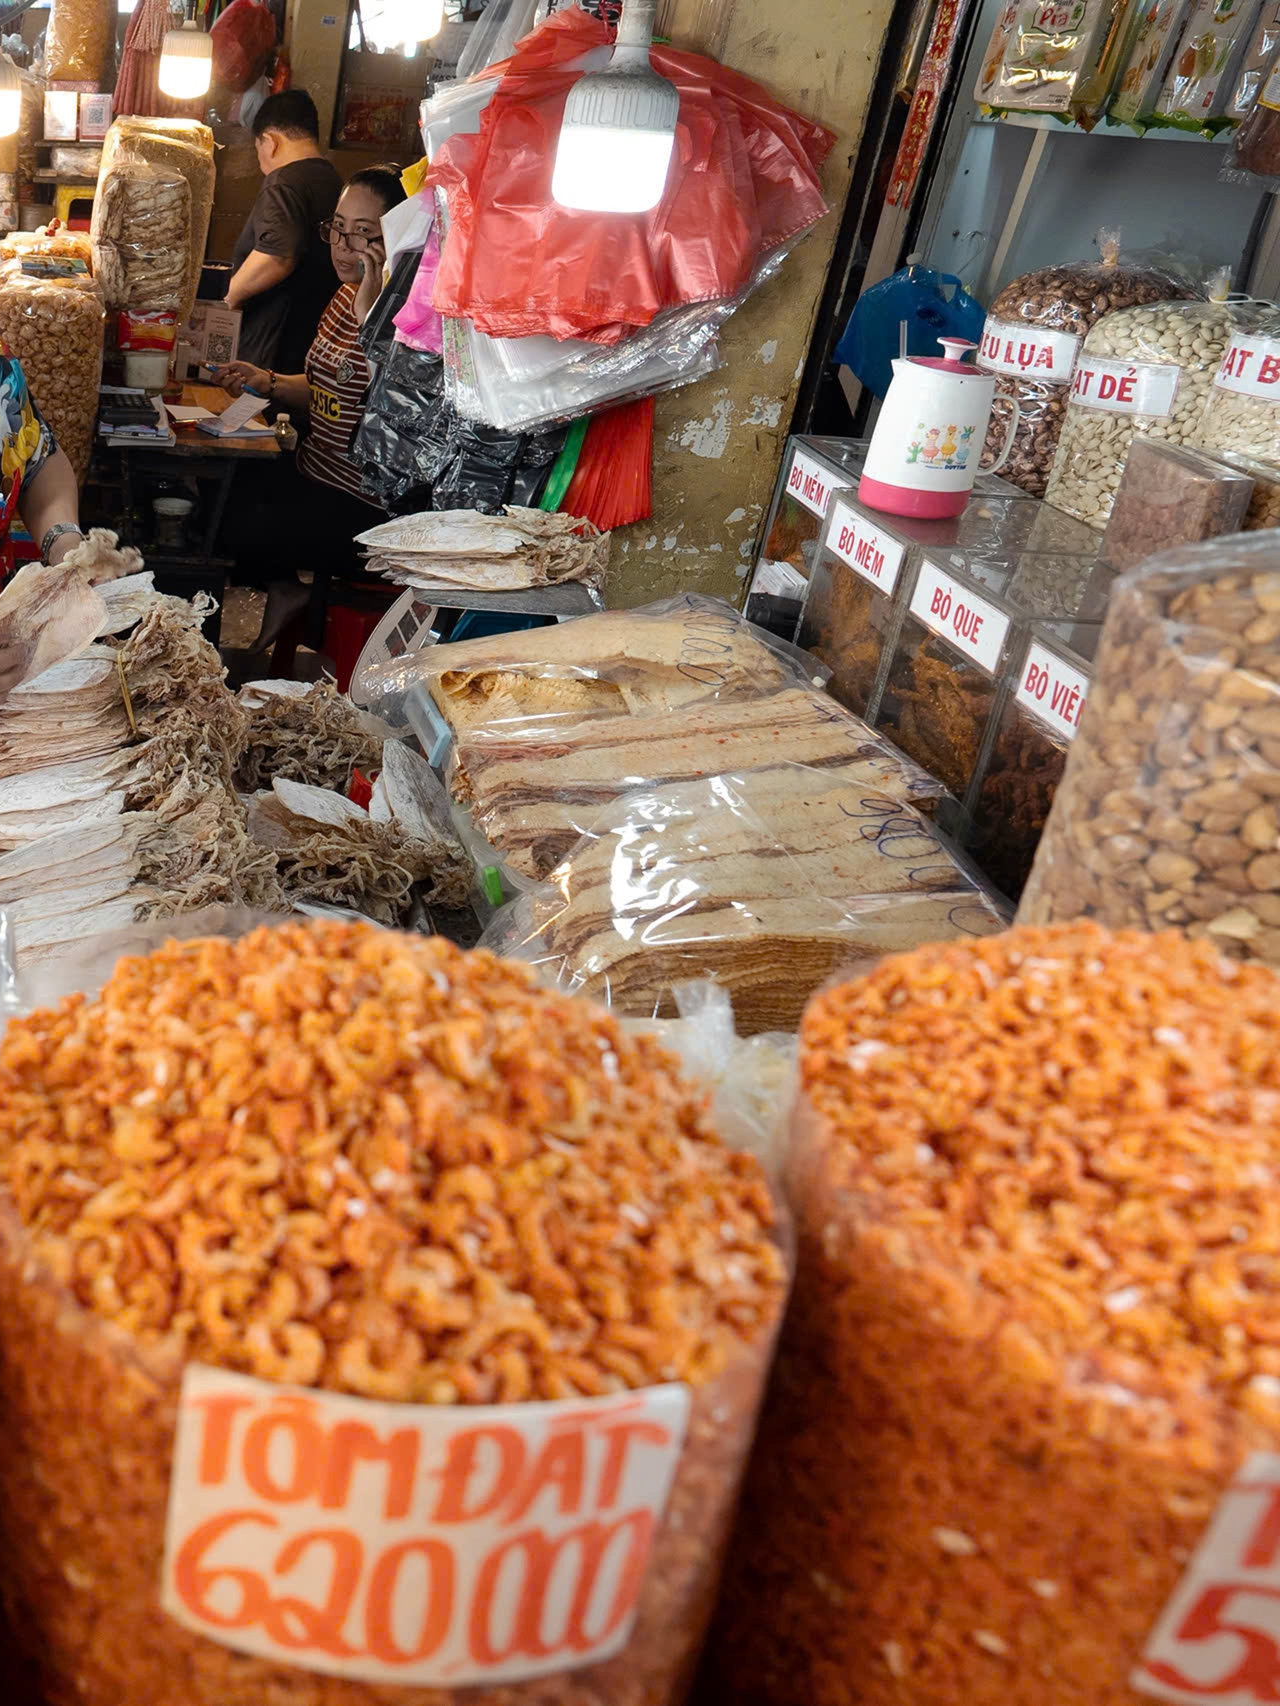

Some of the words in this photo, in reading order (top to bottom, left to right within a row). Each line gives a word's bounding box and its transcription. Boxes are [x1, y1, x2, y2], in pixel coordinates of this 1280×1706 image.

[1097, 366, 1138, 403] DẺ
[930, 586, 952, 621] BÒ
[953, 603, 984, 645] QUE
[1024, 663, 1049, 700] BÒ
[191, 1390, 422, 1522] TÔM
